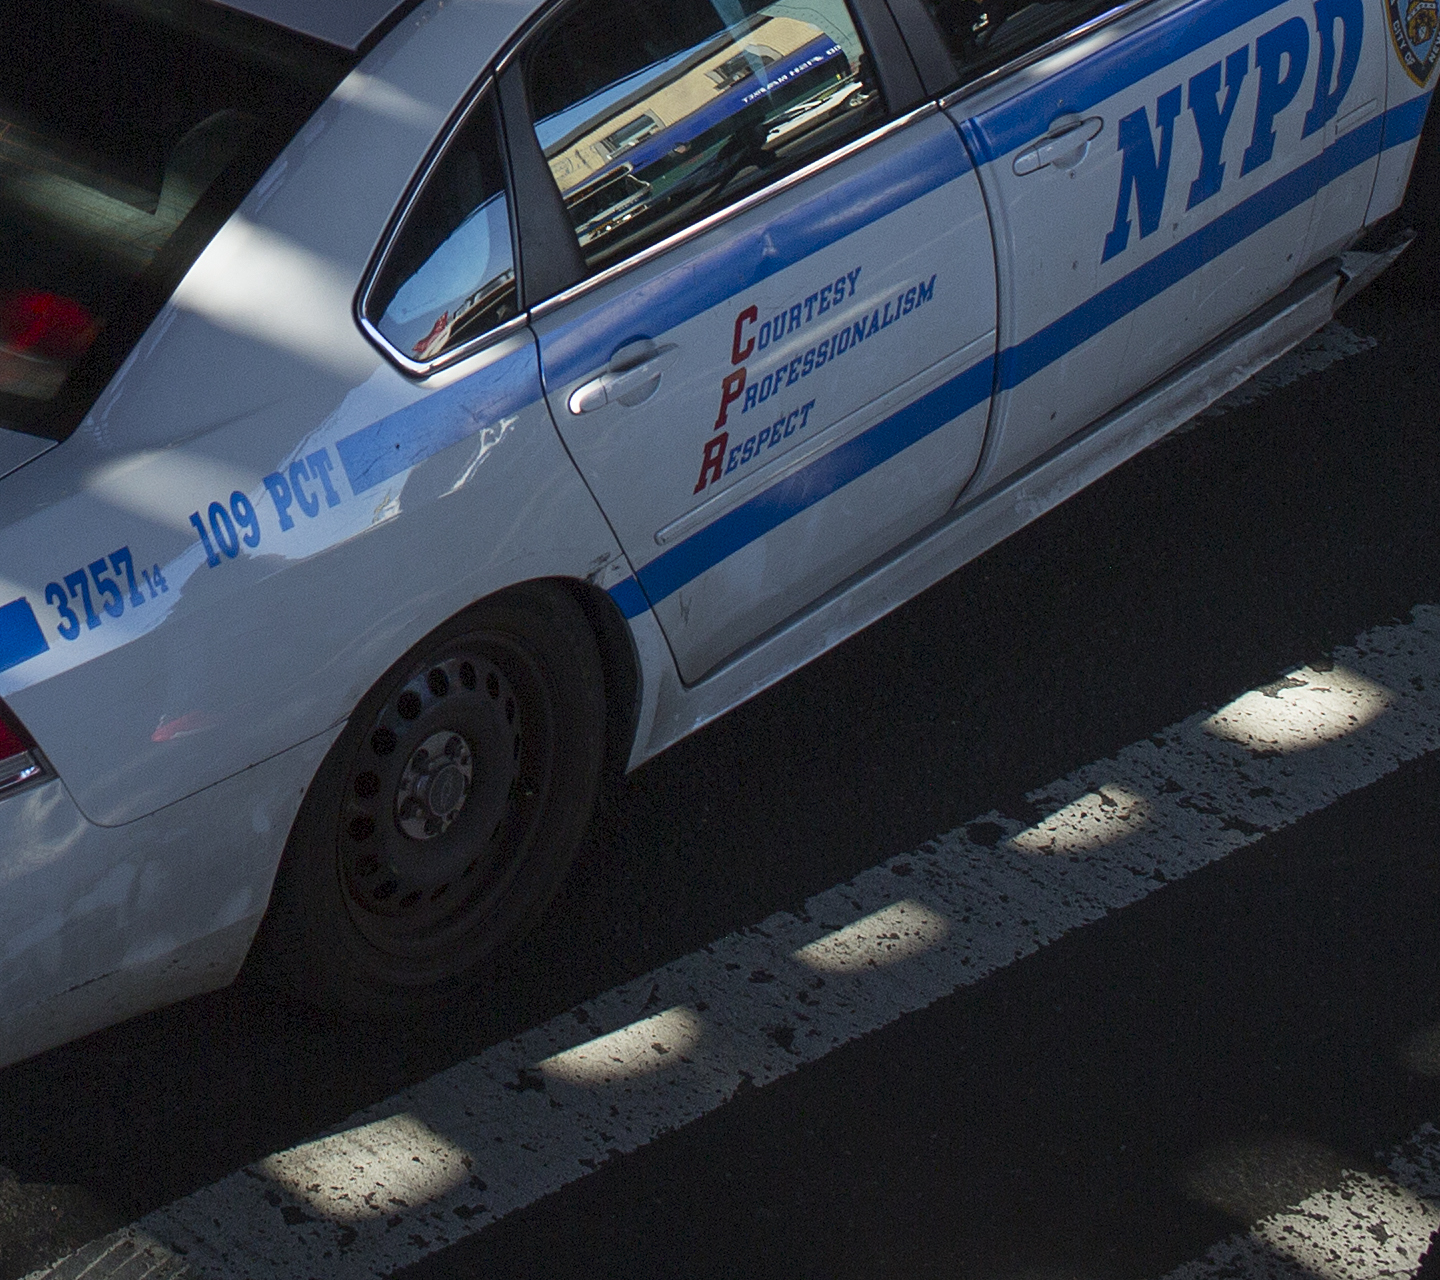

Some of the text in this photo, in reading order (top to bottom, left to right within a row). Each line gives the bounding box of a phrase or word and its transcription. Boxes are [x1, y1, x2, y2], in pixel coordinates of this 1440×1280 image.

[1392, 19, 1407, 51] CITY
[1404, 51, 1416, 66] OF
[713, 273, 938, 432] PROFESSIONALISM
[729, 266, 863, 368] COURTESY
[692, 399, 817, 496] RESPECT
[188, 446, 342, 569] 109 PCT
[44, 544, 170, 642] 3757 14
